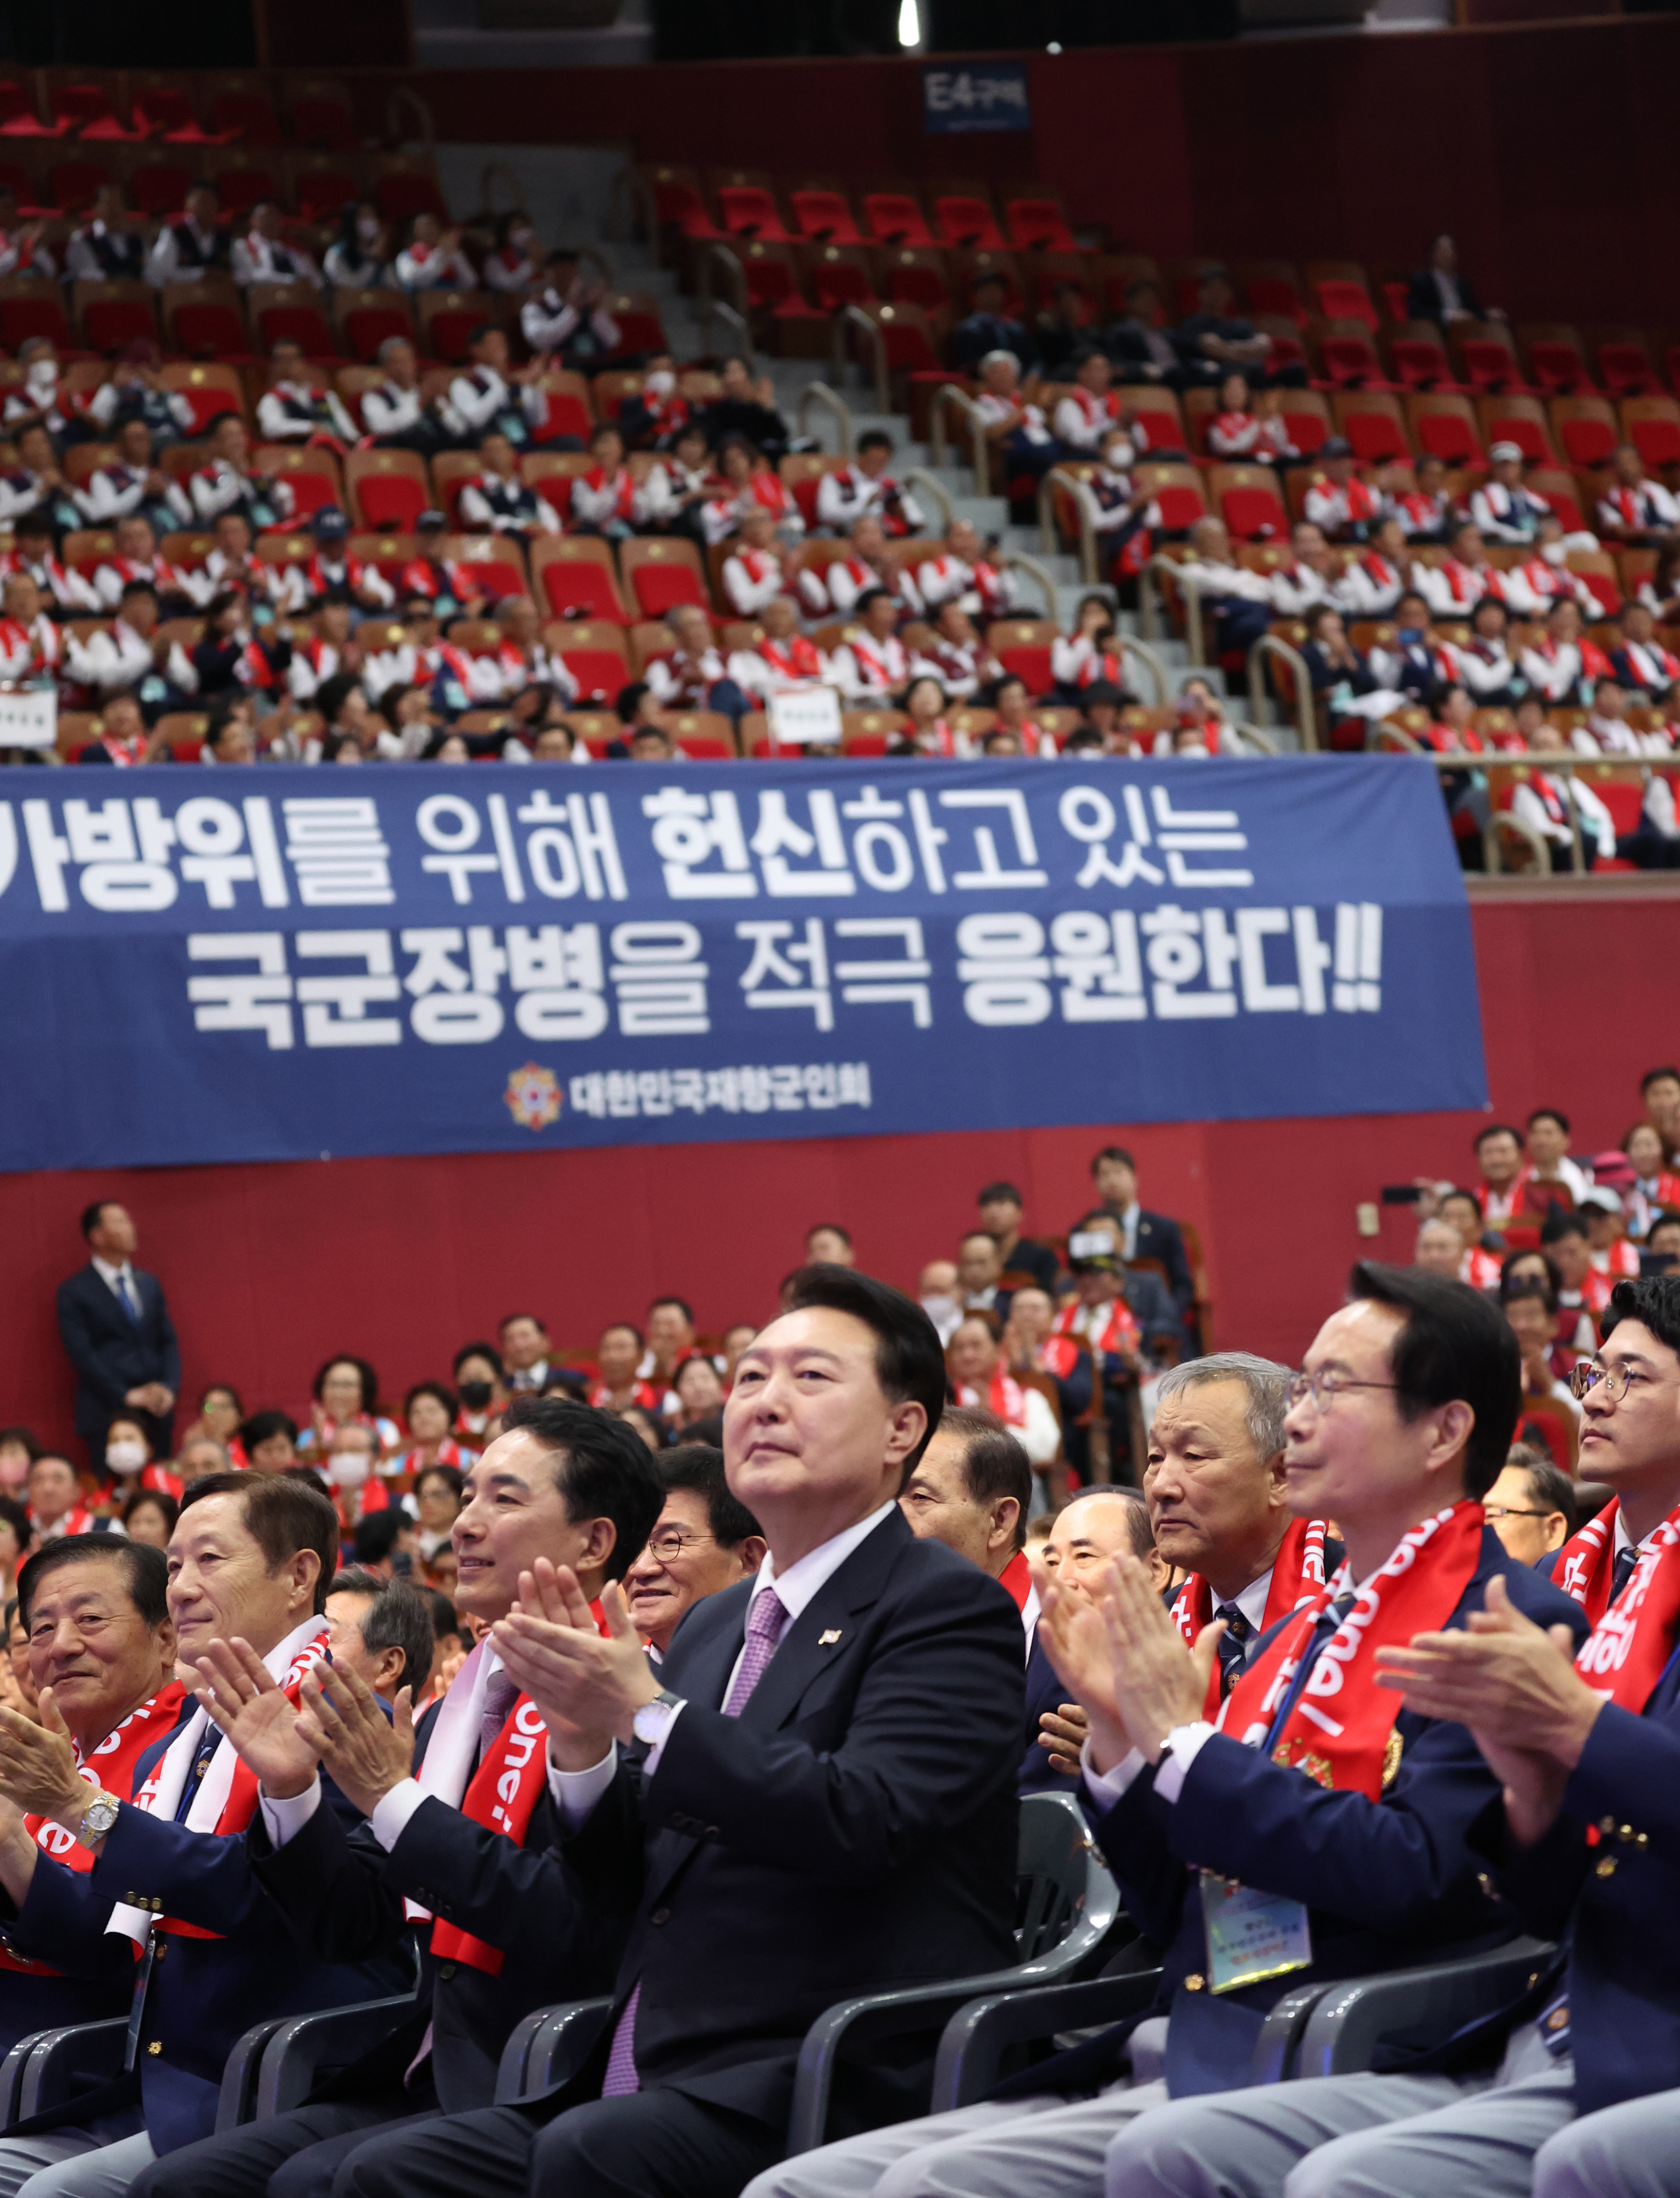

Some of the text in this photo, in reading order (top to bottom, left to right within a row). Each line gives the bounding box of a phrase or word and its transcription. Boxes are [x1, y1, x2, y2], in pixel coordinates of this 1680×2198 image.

[416, 789, 628, 904] 위해
[641, 785, 1049, 900] 헌신하고
[1058, 784, 1254, 889] 있는
[187, 901, 1383, 1050] 국군장병을 적극 응원한다!!
[568, 1062, 872, 1117] 대한민국재향군인회
